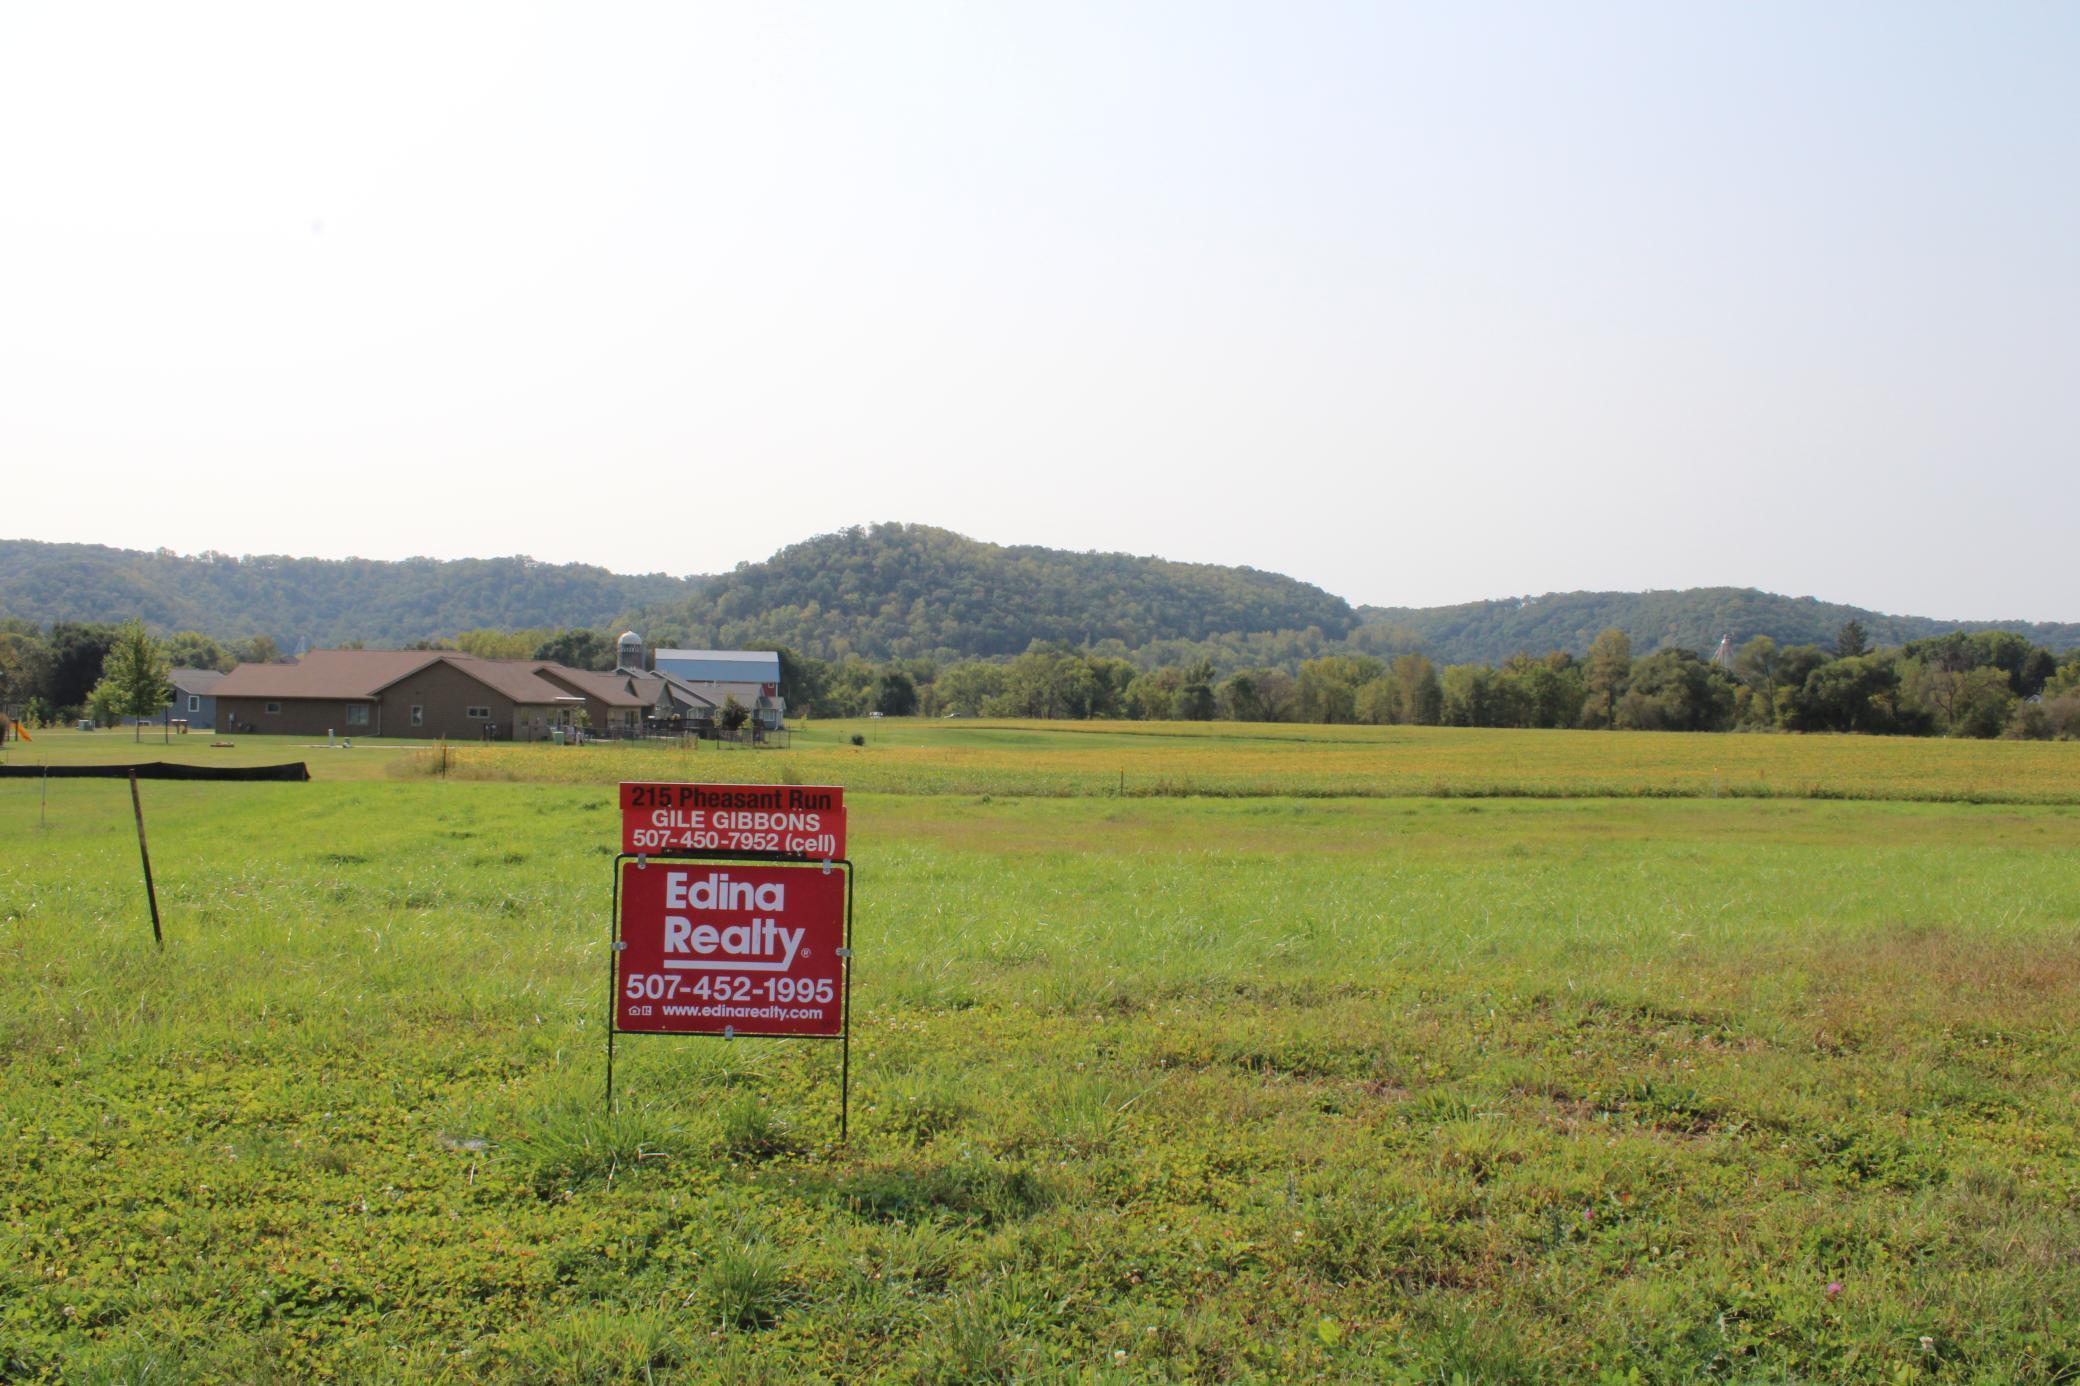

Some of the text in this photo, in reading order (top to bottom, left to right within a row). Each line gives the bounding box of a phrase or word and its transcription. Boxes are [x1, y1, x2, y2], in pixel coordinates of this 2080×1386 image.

[632, 787, 832, 810] 215 Pheasant Run
[652, 810, 821, 832] GILE GIBBONS
[633, 830, 836, 856] 507-450-7952 (cell)
[666, 872, 785, 912] Edina
[664, 916, 806, 971] Realty
[626, 974, 834, 1004] 507-452-1995
[663, 1005, 823, 1021] www.edinarealty.com
